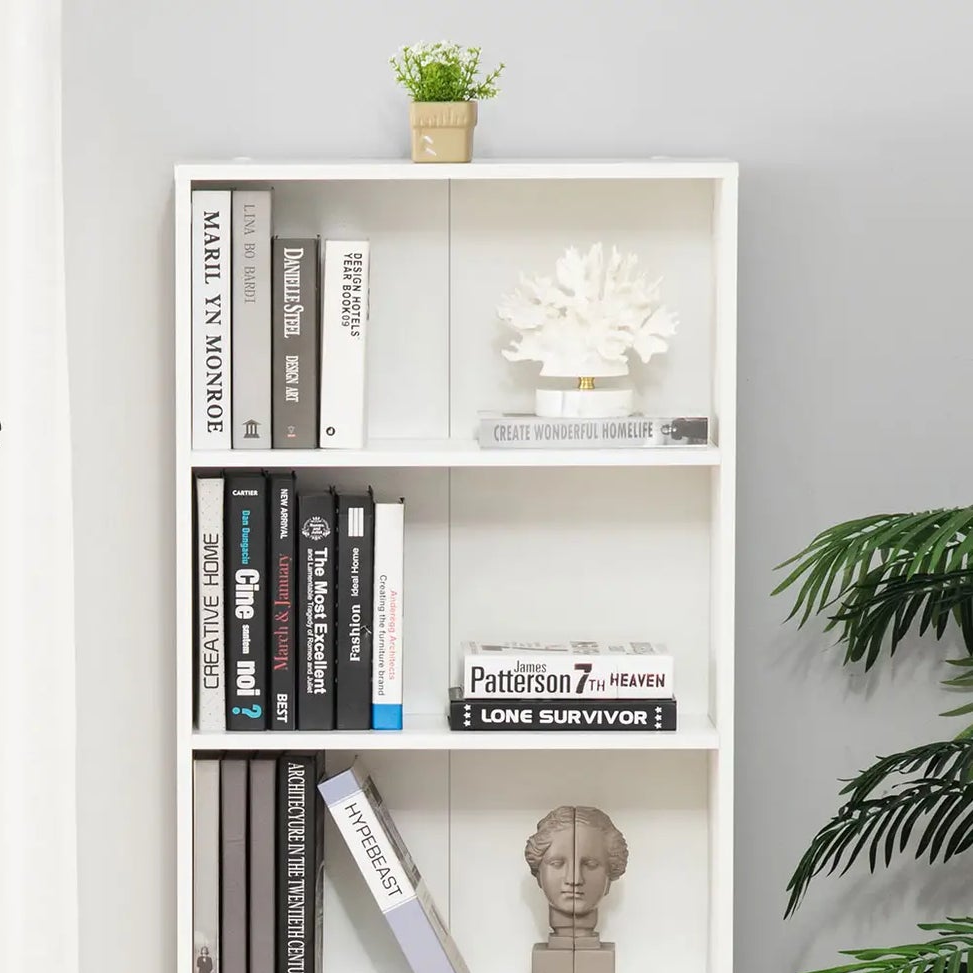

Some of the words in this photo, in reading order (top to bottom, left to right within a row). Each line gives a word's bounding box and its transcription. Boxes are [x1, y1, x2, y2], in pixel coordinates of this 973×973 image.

[244, 204, 255, 235] LINA
[244, 243, 255, 258] BO
[342, 253, 352, 280] YEAR
[352, 253, 363, 292] DESIGN
[244, 267, 256, 304] BARDI
[350, 297, 362, 337] HOTELS
[206, 335, 223, 433] MONROE
[286, 356, 299, 384] DESIGN
[286, 387, 299, 402] ART
[494, 425, 530, 441] CREATE
[534, 423, 598, 440] WONDERFUL
[602, 422, 653, 439] HOMELIFE
[280, 489, 288, 506] NEW
[242, 510, 250, 526] Dan
[280, 508, 288, 539] ARRIVAL
[204, 533, 219, 586] HOME
[314, 548, 328, 577] The
[351, 548, 360, 572] Home
[235, 569, 260, 619] Cine
[274, 554, 292, 605] January
[351, 575, 359, 596] Ideal
[378, 575, 387, 611] Creating
[305, 602, 313, 628] Tragedy
[314, 581, 328, 619] Most
[277, 612, 290, 622] &
[204, 596, 219, 689] CREATIVE
[349, 604, 361, 661] Fashion
[274, 626, 290, 670] March
[314, 623, 327, 694] Excellent
[236, 661, 261, 696] noi
[471, 666, 571, 693] Patterson
[610, 673, 665, 688] HEAVEN
[514, 660, 546, 673] James
[277, 693, 288, 722] BEST
[482, 709, 532, 723] LONE
[540, 709, 647, 724] SURVIVOR
[288, 844, 304, 856] IN
[345, 802, 402, 897] HYPEBEAST
[288, 857, 304, 877] THE
[288, 879, 305, 939] TWENTIETH
